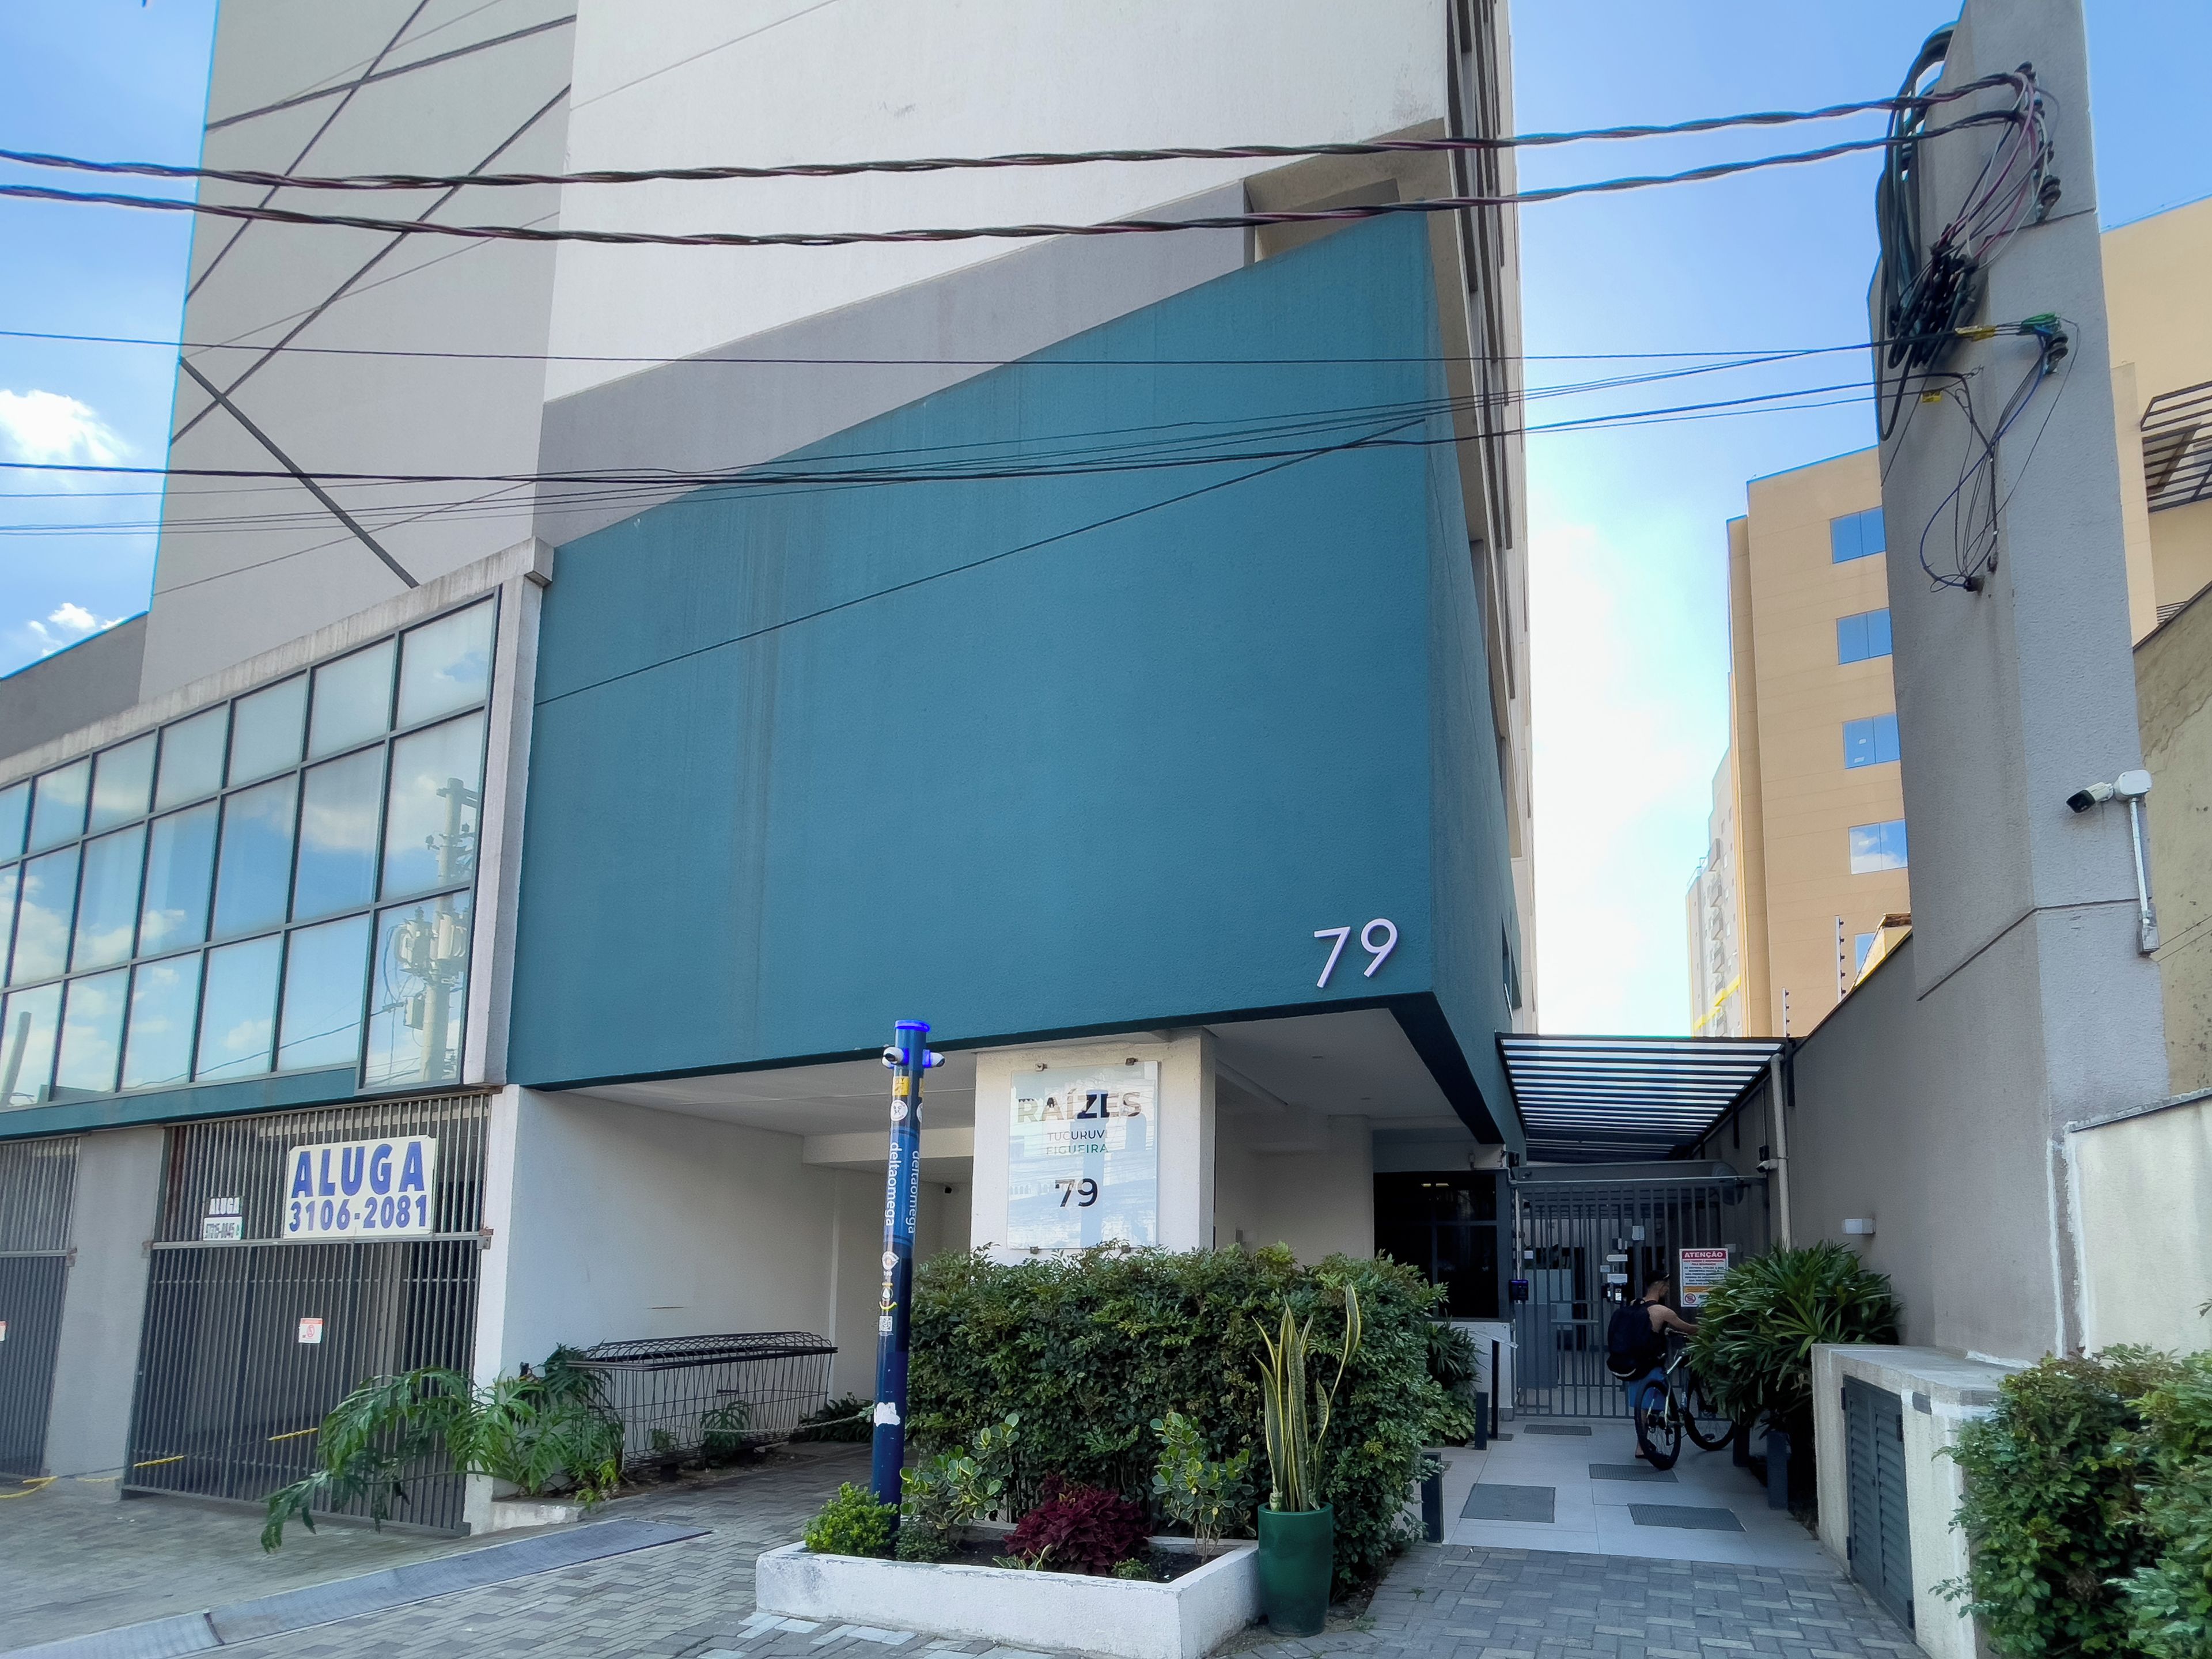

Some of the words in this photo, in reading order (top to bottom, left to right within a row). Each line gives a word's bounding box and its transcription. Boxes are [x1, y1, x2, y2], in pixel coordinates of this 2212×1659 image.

[1313, 918, 1399, 988] 79
[1017, 1088, 1142, 1123] RAÍZES
[1046, 1143, 1109, 1155] FIGUEIRA
[291, 1141, 425, 1198] ALUGA
[885, 1142, 902, 1226] deltaomega
[209, 1197, 240, 1215] ALUGA
[1055, 1178, 1098, 1207] 79
[289, 1195, 427, 1232] 3106-2081
[1684, 1251, 1724, 1259] ATENÇÃO
